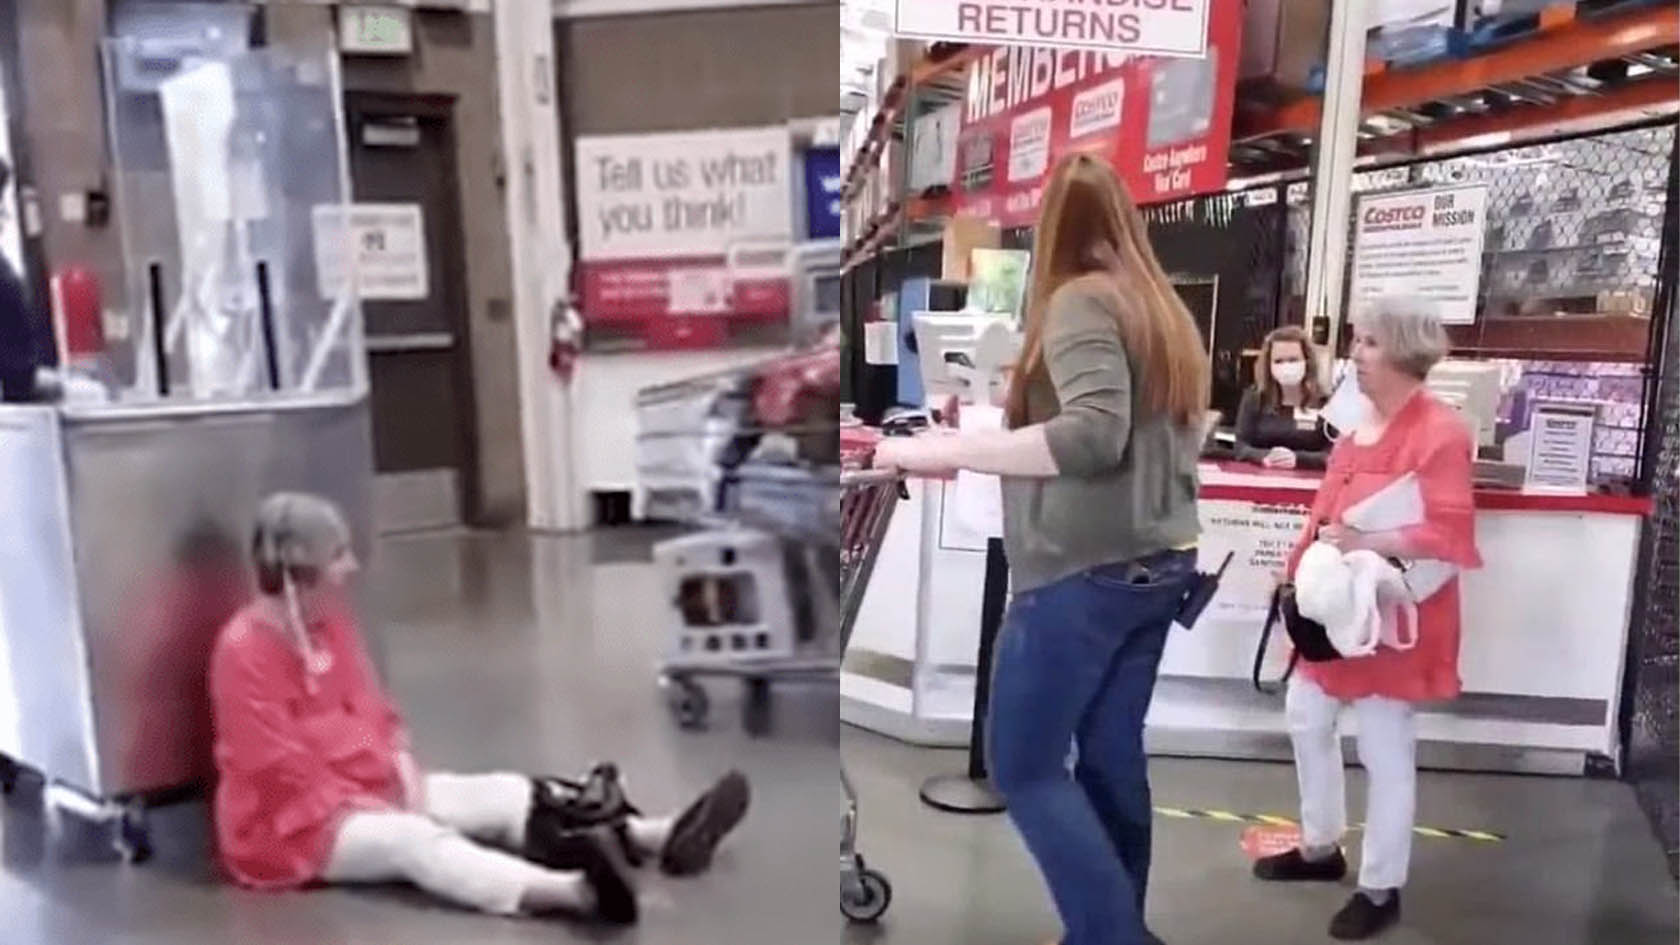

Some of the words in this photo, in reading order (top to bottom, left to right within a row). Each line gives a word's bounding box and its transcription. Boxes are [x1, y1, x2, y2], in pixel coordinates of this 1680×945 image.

[957, 3, 1141, 43] RETURNS
[596, 154, 643, 191] Tell
[653, 159, 690, 190] us
[701, 150, 777, 187] what
[600, 203, 652, 241] you
[663, 193, 747, 231] think!
[1363, 205, 1426, 225] COSTCO
[1434, 194, 1455, 210] OUR
[1433, 211, 1475, 227] MISSION
